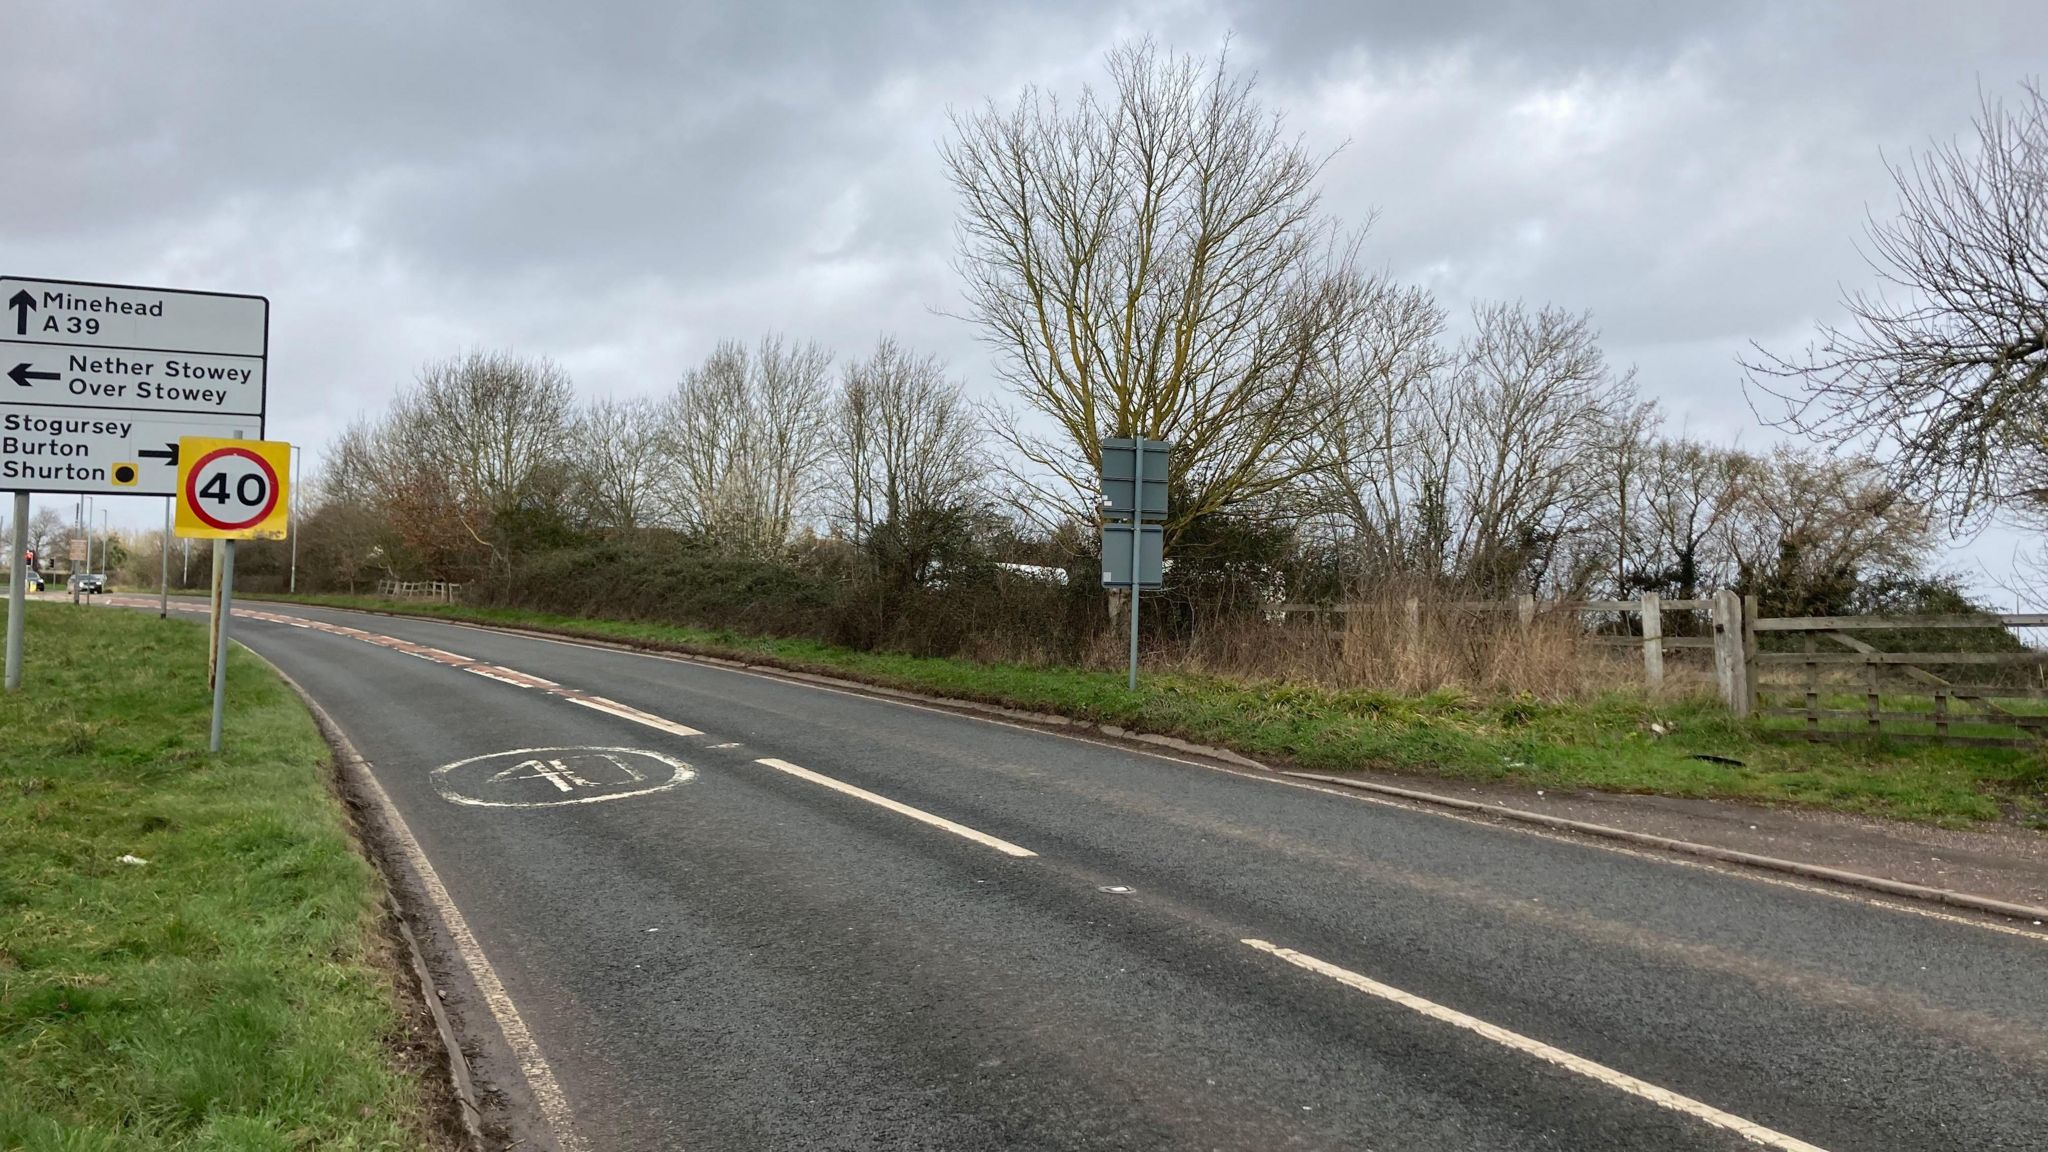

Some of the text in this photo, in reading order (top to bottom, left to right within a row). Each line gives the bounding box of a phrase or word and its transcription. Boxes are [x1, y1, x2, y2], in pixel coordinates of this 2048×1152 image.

[43, 291, 163, 317] Minehead
[69, 354, 252, 385] Nether Stowey
[68, 378, 227, 406] Over Stowey
[3, 413, 133, 438] Stogursey
[2, 437, 89, 457] Burton
[2, 460, 105, 481] Shurton
[198, 472, 267, 507] 40
